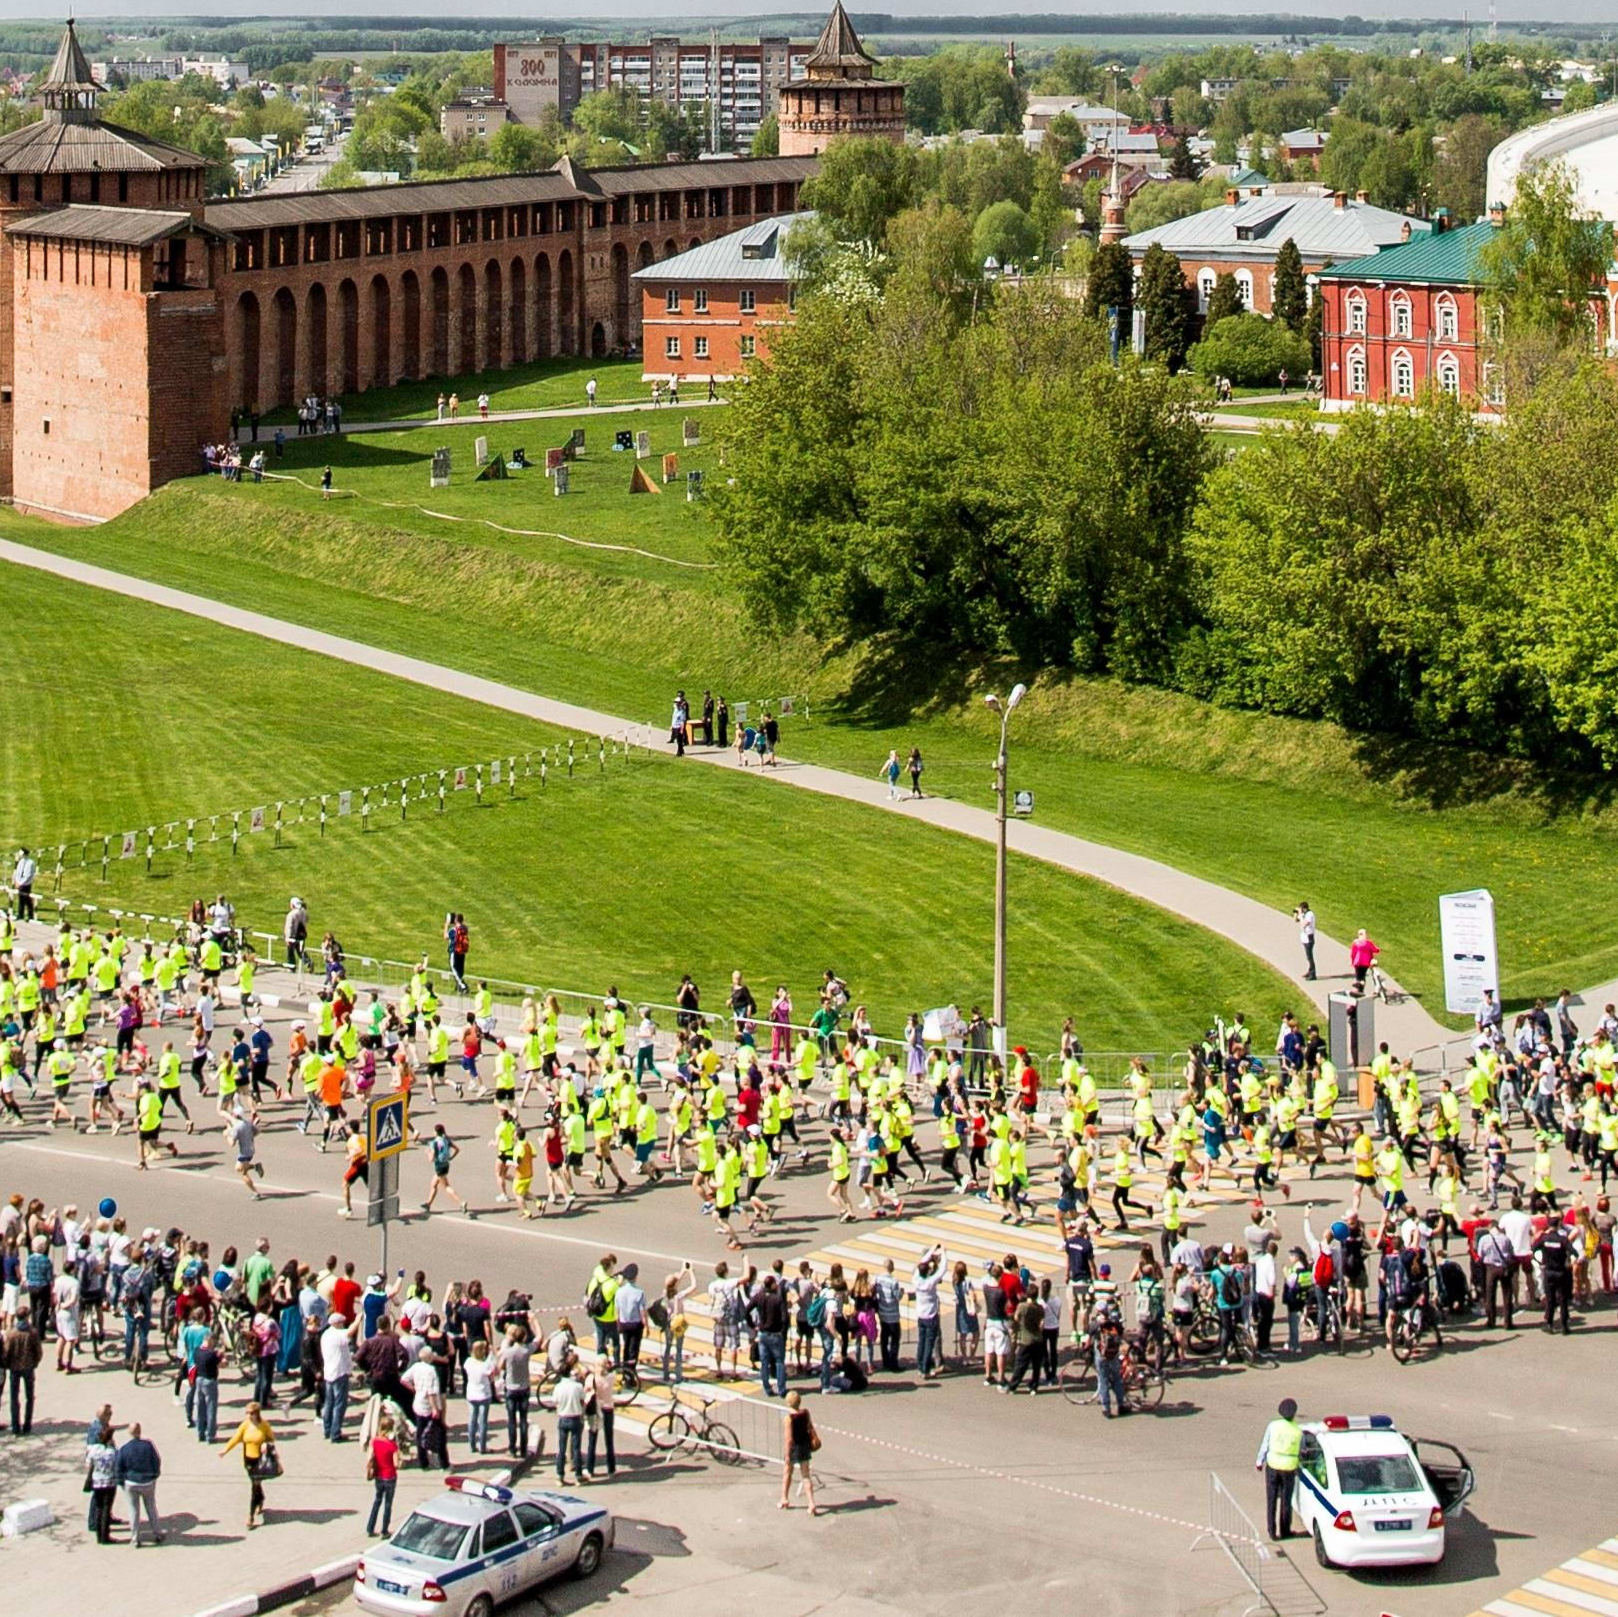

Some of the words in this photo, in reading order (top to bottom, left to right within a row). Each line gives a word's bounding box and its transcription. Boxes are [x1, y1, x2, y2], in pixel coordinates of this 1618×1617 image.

[520, 59, 545, 76] 800
[507, 78, 558, 87] КОЛОМНА
[1363, 1496, 1418, 1507] ДПС
[501, 1574, 517, 1591] 112
